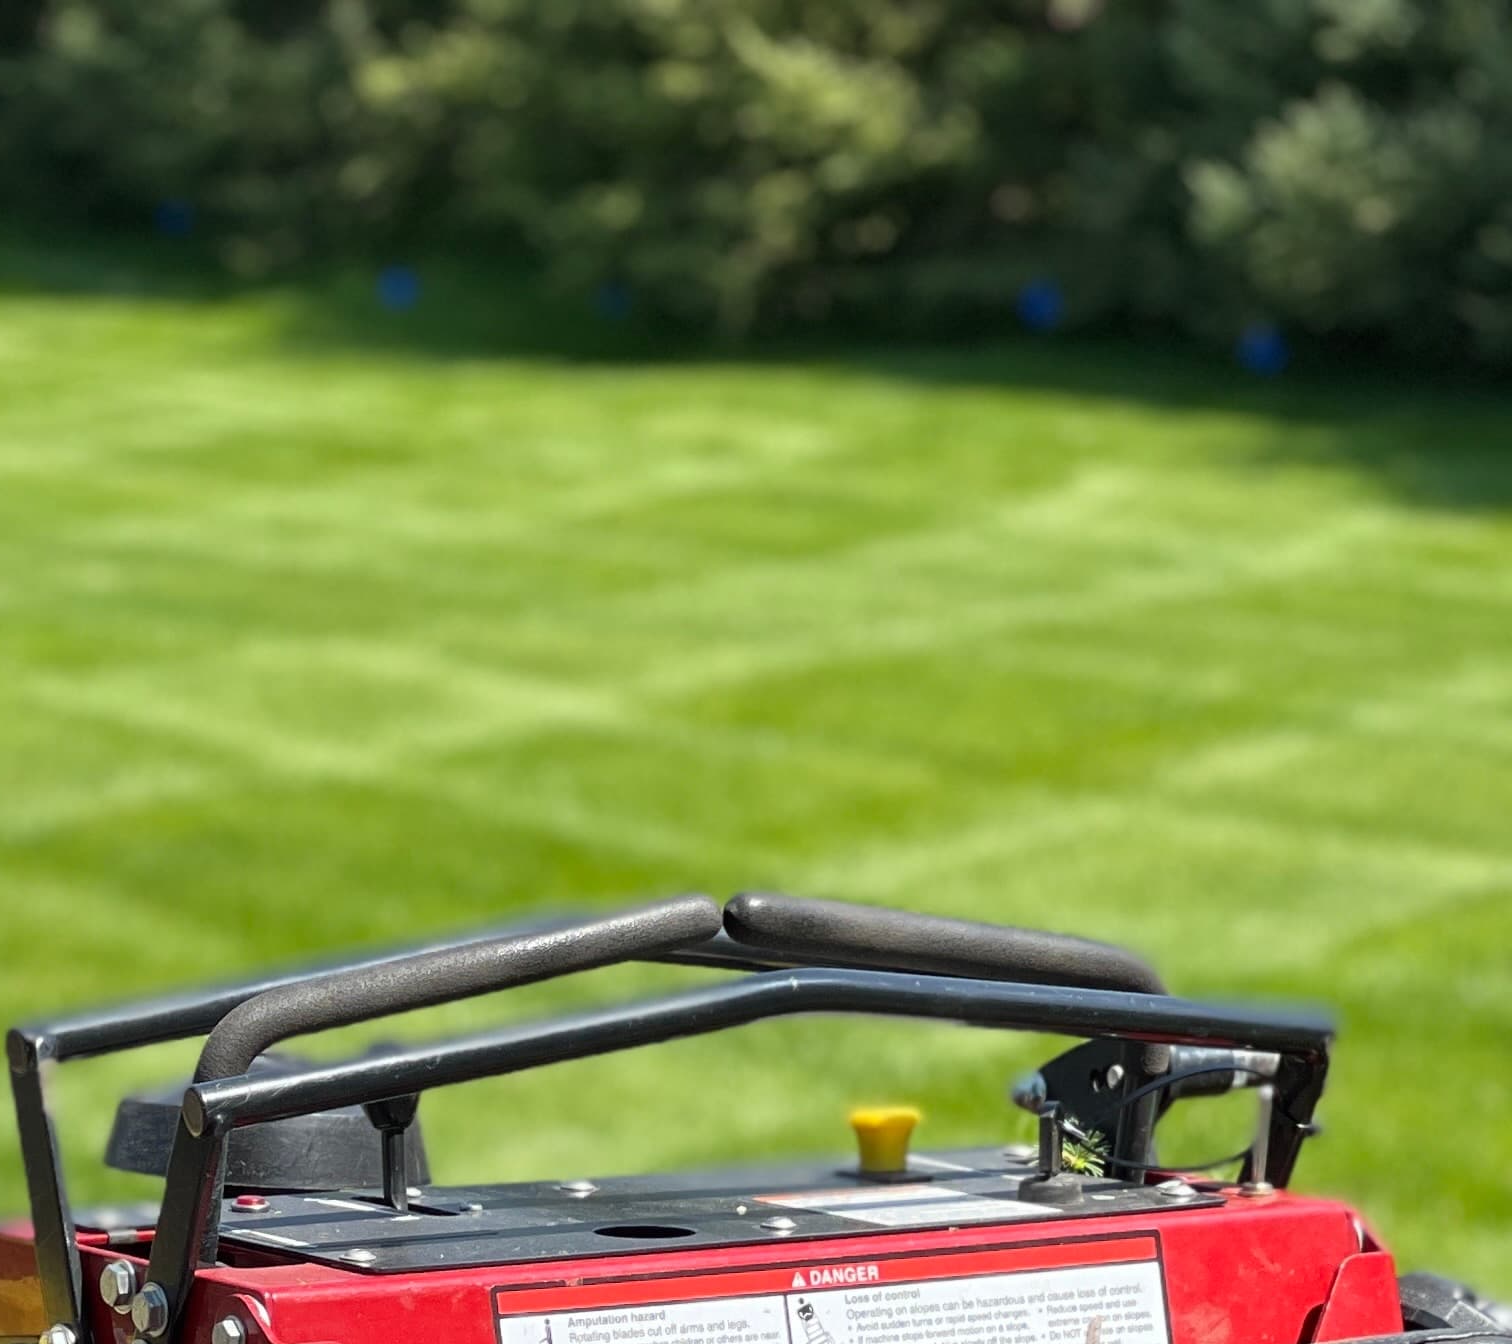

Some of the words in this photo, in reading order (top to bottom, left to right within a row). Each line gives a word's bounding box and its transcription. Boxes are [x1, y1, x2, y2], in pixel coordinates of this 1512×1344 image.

[809, 1266, 879, 1286] DANGER
[844, 1294, 869, 1304] Loss
[871, 1290, 882, 1302] of
[884, 1288, 920, 1301] control
[845, 1307, 893, 1320] Operating
[894, 1305, 907, 1316] on
[909, 1303, 940, 1314] slopes
[942, 1301, 960, 1311] can
[961, 1297, 974, 1309] be
[975, 1295, 1025, 1307] hazardous
[1027, 1291, 1045, 1304] and
[1046, 1290, 1075, 1299] cause
[1076, 1287, 1096, 1298] loss
[1097, 1285, 1107, 1297] of
[1109, 1282, 1142, 1296] control.
[1046, 1304, 1077, 1314] Reduce
[1078, 1300, 1103, 1312] speed
[1104, 1299, 1120, 1309] and
[567, 1314, 628, 1328] Amputation
[630, 1309, 665, 1322] hazard
[856, 1321, 879, 1332] Avoid
[880, 1319, 910, 1330] sudden
[911, 1318, 933, 1327] turns
[934, 1316, 943, 1325] or
[944, 1313, 965, 1325] rapid
[967, 1311, 992, 1322] speed
[1111, 1313, 1123, 1321] on
[568, 1331, 610, 1344] Rotating
[612, 1327, 645, 1339] blades
[646, 1325, 662, 1336] cut
[664, 1323, 677, 1335] off
[679, 1323, 704, 1334] arms
[706, 1319, 725, 1332] and
[727, 1319, 750, 1331] legs.
[705, 1336, 714, 1344] or
[716, 1334, 743, 1344] others
[744, 1333, 759, 1342] are
[865, 1334, 899, 1344] machine
[985, 1325, 996, 1333] on
[998, 1336, 1012, 1344] the
[1048, 1330, 1061, 1341] Do
[1062, 1327, 1081, 1338] NOT
